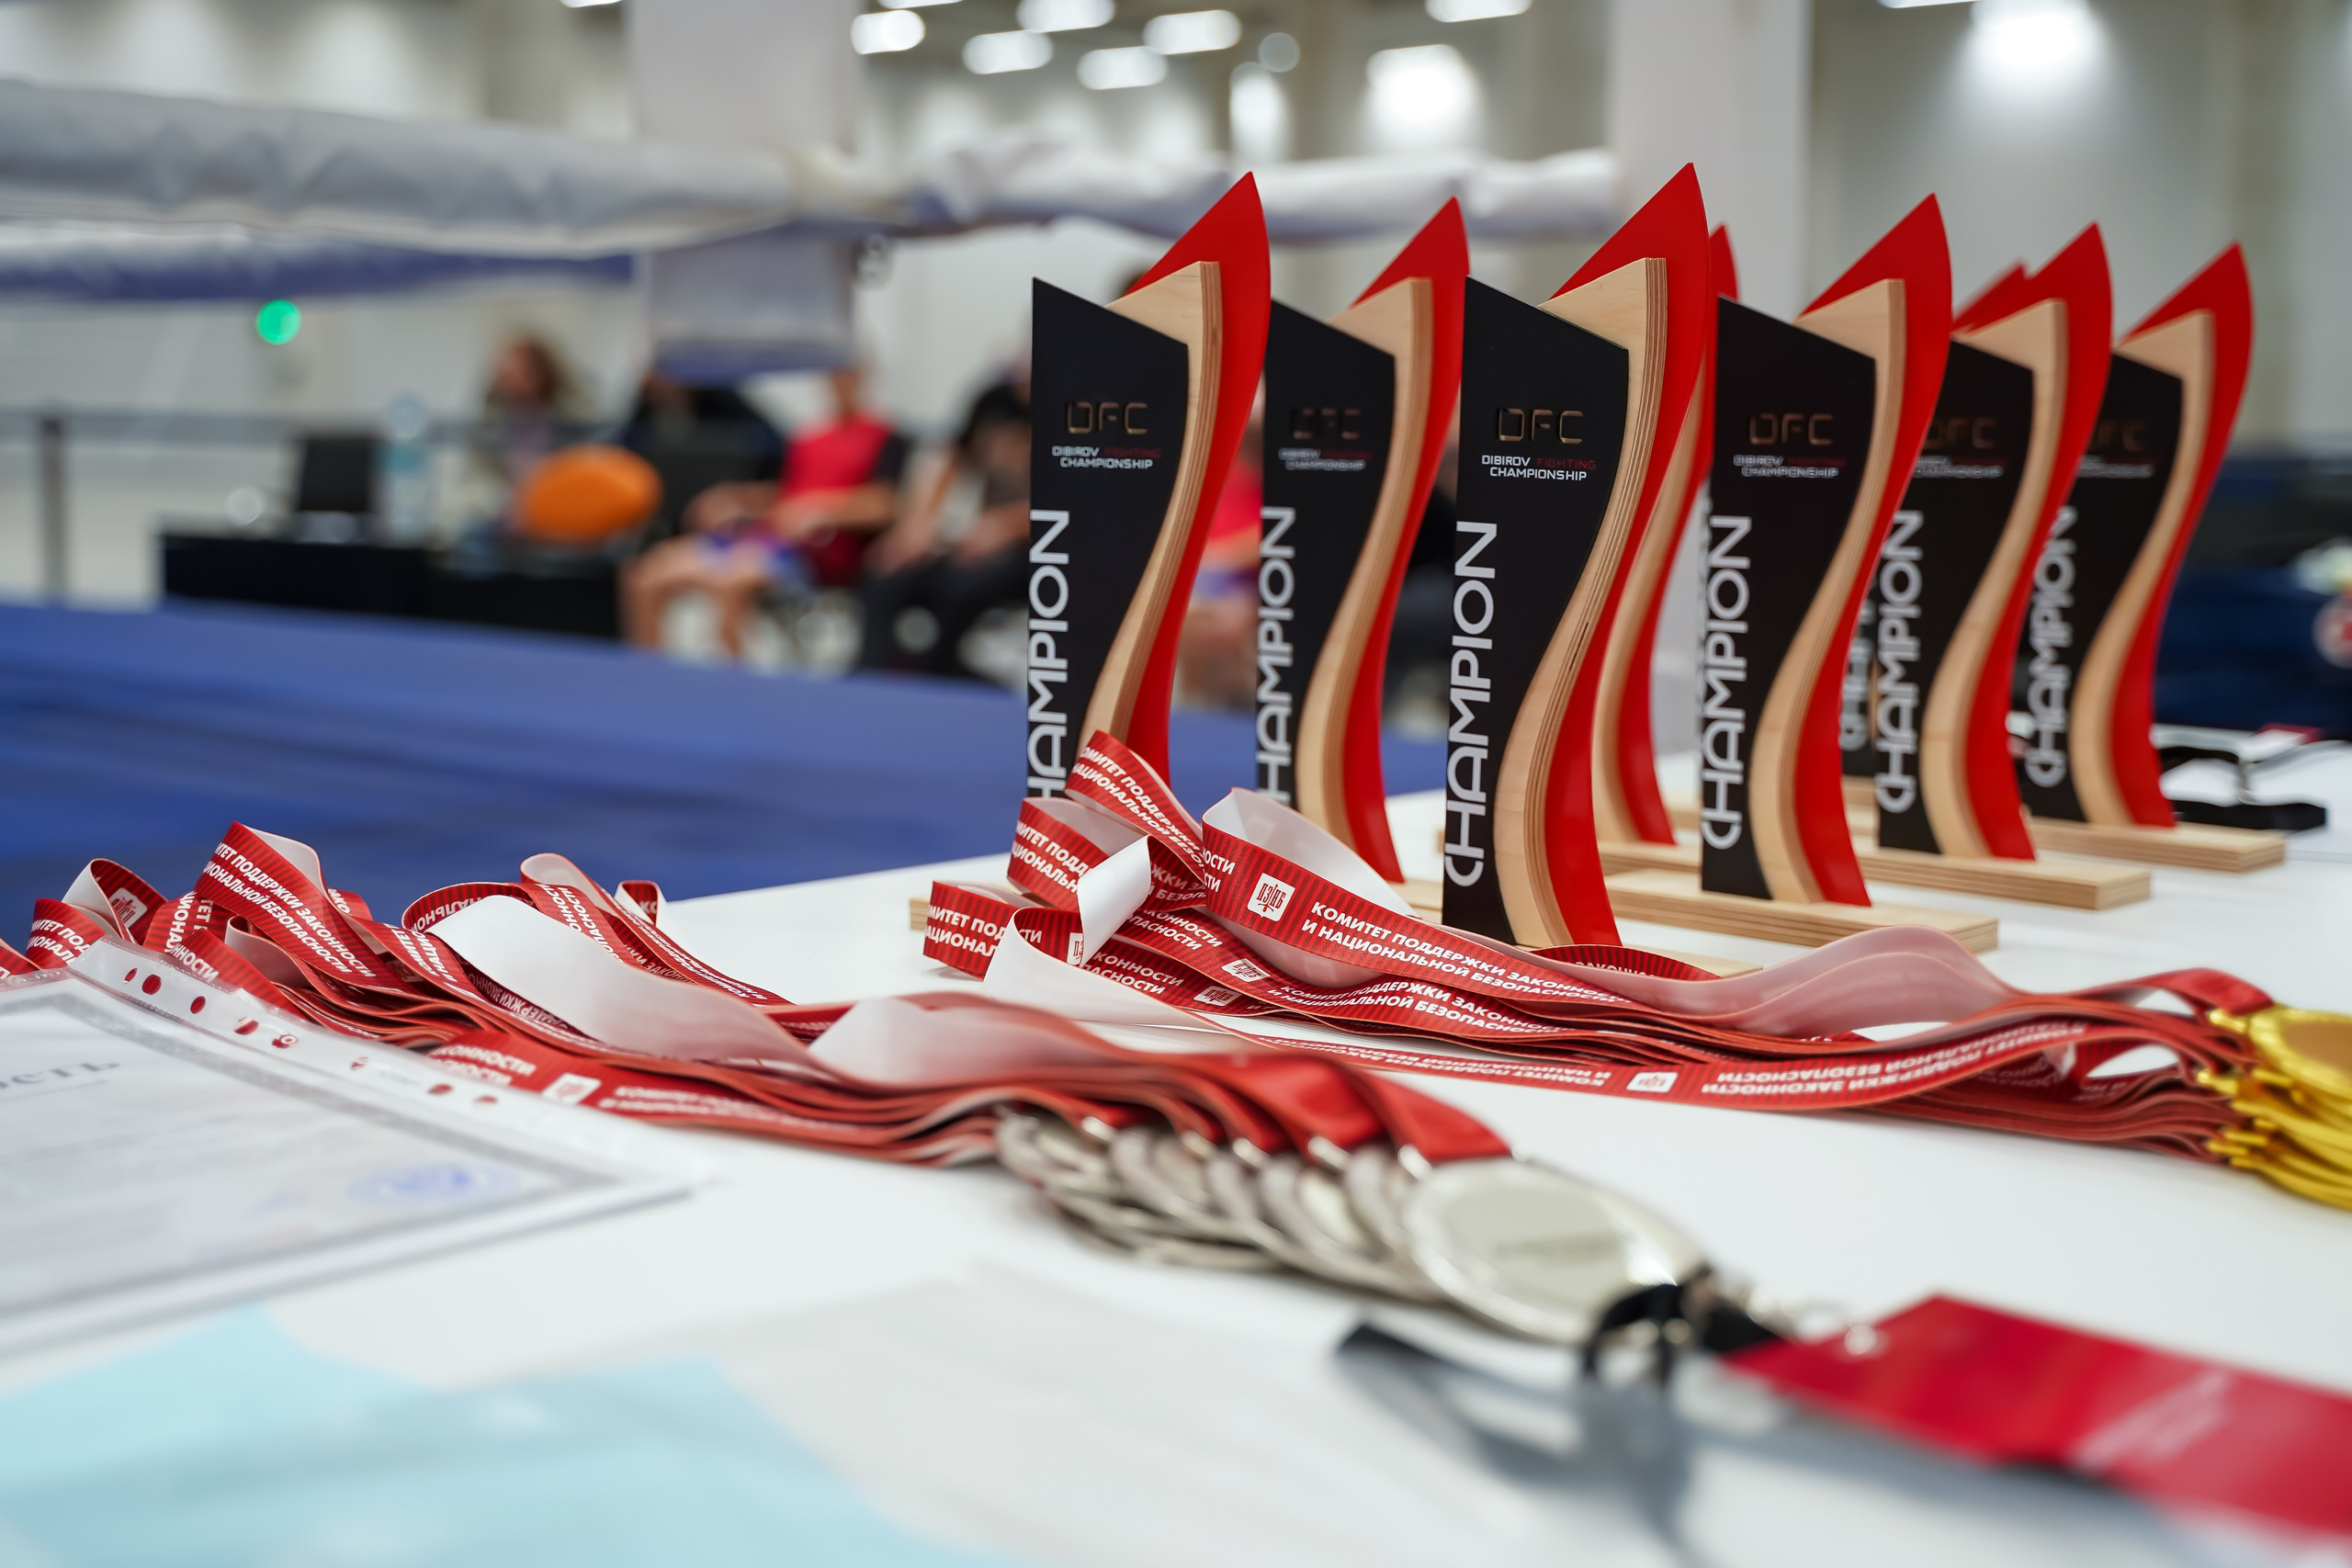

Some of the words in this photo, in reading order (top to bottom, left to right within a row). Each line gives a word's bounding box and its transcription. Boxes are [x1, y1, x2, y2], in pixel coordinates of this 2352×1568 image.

[1060, 457, 1153, 469] CHAMPIONSHIP
[1481, 455, 1532, 467] DIBIROV
[1536, 457, 1597, 470] FIGHTING
[1489, 467, 1587, 481] CHAMPIONSHIP
[1256, 506, 1296, 802] HAMPION
[1874, 509, 1924, 813] CHAMPION
[1702, 515, 1752, 850] CHAMPION
[1444, 521, 1498, 886] CHAMPION
[1080, 747, 1126, 777] ОМИТЕТ
[231, 855, 304, 909] ПОДДЕРЖКИ
[297, 908, 377, 977] ЗАКОННОСТИ
[261, 900, 354, 974] БЕЗОПАСНОСТИ
[1311, 901, 1392, 940] КОМИТЕТ
[1392, 933, 1506, 976] ПОДДЕРЖКИ
[1093, 952, 1184, 987] КОННОСТИ
[1301, 919, 1318, 934] И
[1317, 924, 1471, 977] НАЦИОНАЛЬНОЙ
[1471, 970, 1617, 1003] БЕЗОПАСНОСТИ
[1280, 994, 1414, 1009] НАЦИОНАЛЬНОЙ
[1345, 981, 1452, 1002] ПОДДЕРЖКИ
[1701, 1080, 1844, 1094] ЗАКОННОСТИ
[1717, 1063, 1881, 1083] БЕЗОПАСНОСТИ
